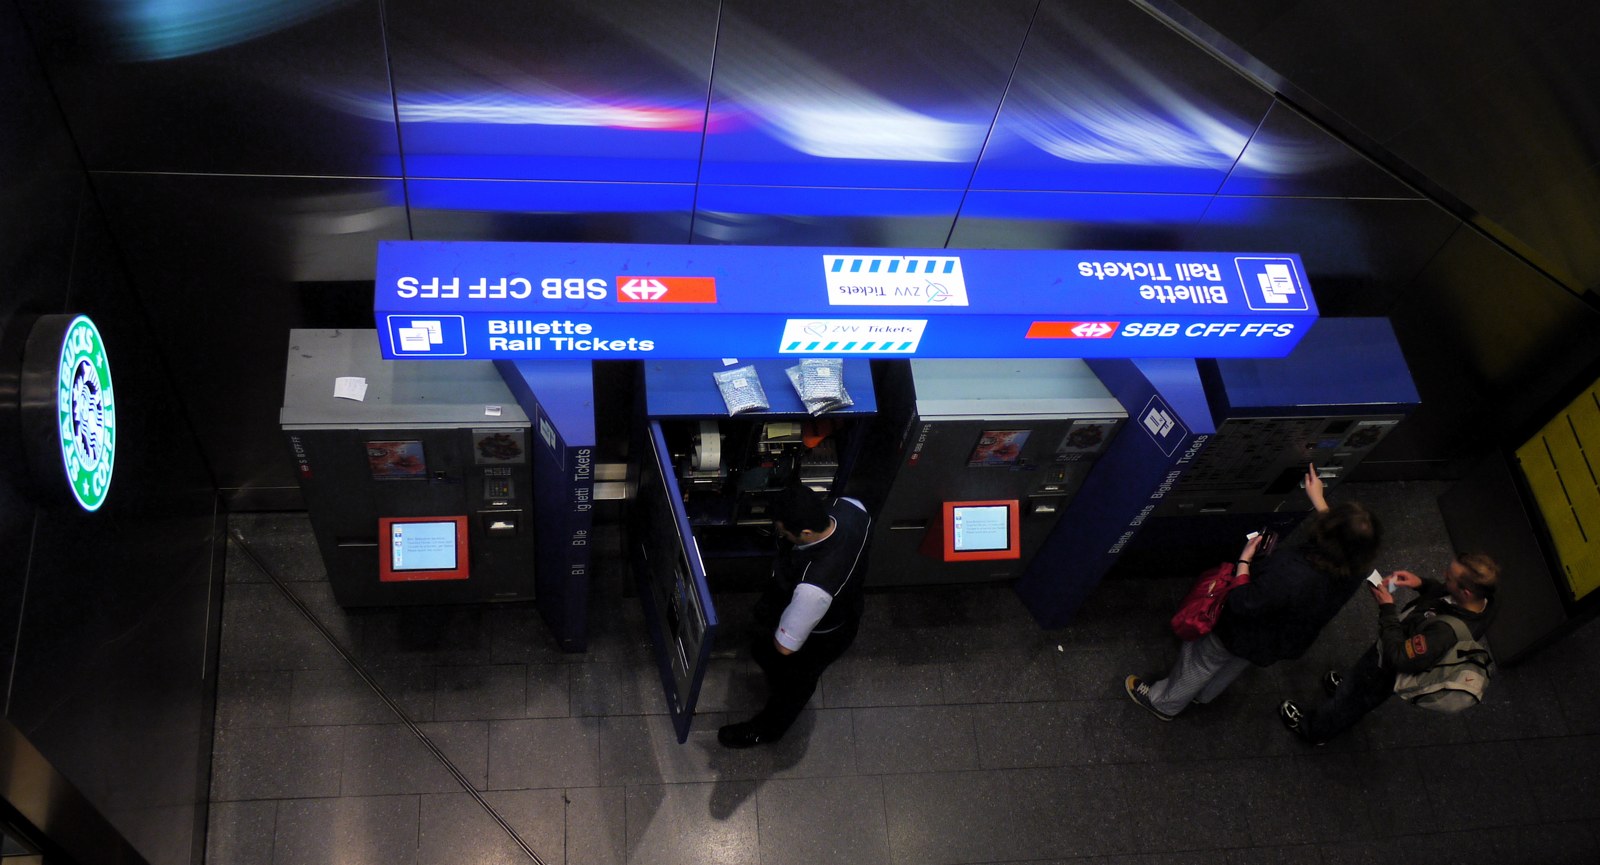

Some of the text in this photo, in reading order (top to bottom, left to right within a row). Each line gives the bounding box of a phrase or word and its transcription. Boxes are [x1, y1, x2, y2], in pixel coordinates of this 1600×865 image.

[1078, 261, 1221, 281] Rail Tickets
[397, 276, 608, 300] SBB CFF FFS
[839, 286, 921, 297] ZVV Tickets
[1139, 285, 1228, 303] Billette
[488, 320, 593, 335] Billette
[868, 325, 913, 333] Tickets
[1121, 322, 1294, 338] SBB CFF FFS
[489, 336, 655, 351] Rail Tickets
[61, 326, 94, 482] STARBUCKS
[92, 386, 113, 496] COFFEE
[574, 448, 591, 481] Tickets
[1107, 434, 1208, 554] Billette Billets Biglietti Tickets
